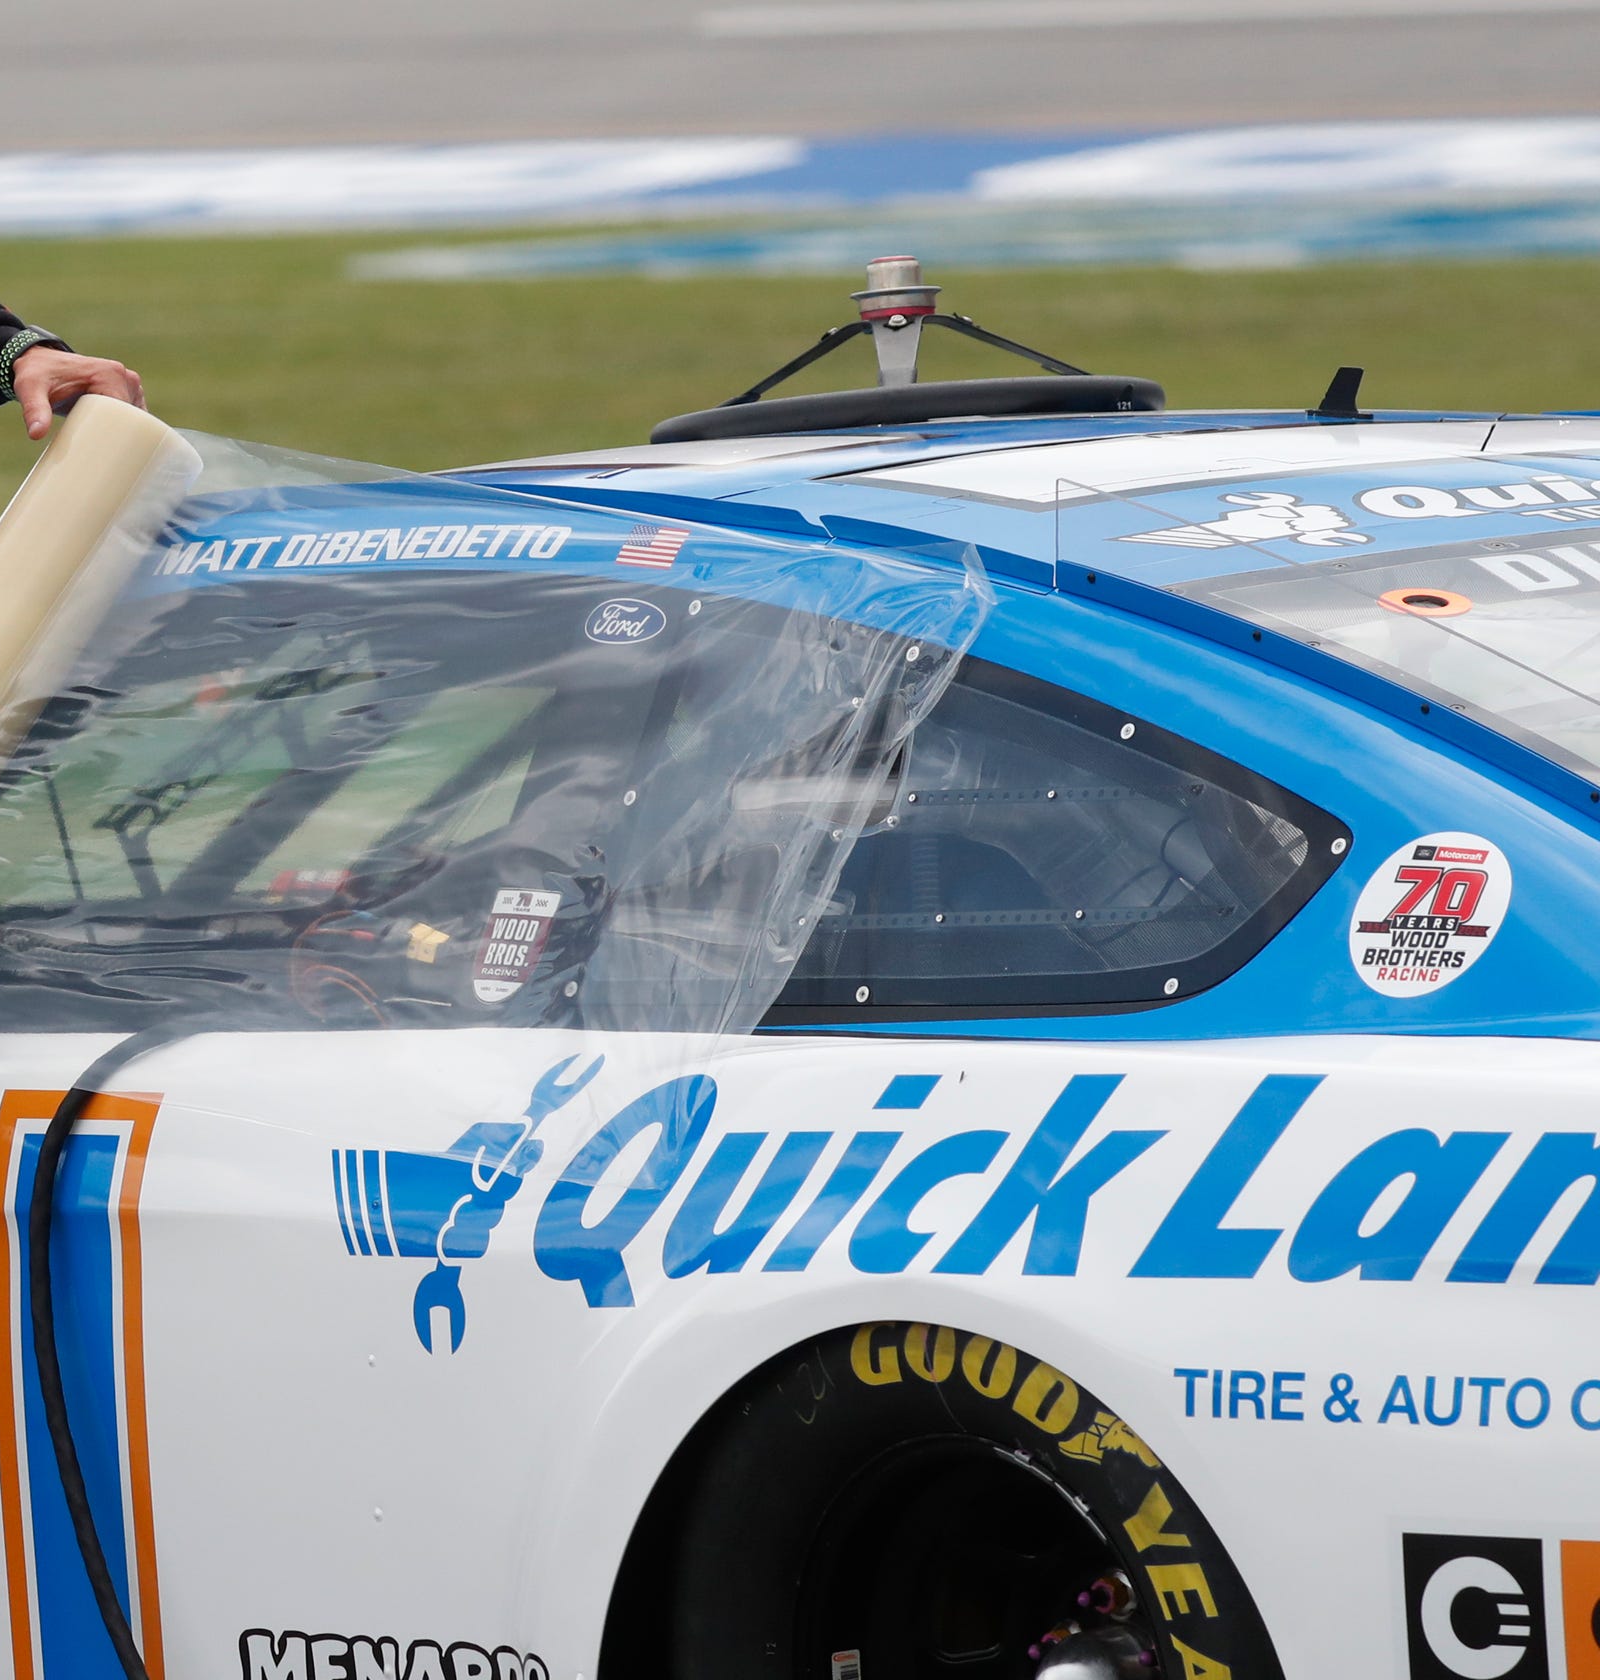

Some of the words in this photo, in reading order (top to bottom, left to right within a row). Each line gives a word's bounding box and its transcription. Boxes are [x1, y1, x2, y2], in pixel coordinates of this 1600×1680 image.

[1357, 474, 1600, 520] Quic
[153, 536, 281, 576] MATT
[275, 524, 572, 569] DiBENEDETTO
[593, 604, 650, 639] Ford
[1438, 849, 1483, 861] Motorcraft
[1383, 865, 1489, 924] 70
[491, 918, 540, 941] WOOD
[1395, 916, 1456, 930] YEARS
[1391, 931, 1450, 948] WOOD
[483, 943, 529, 967] BROS.
[1362, 949, 1466, 968] BROTHERS
[480, 968, 520, 977] RACING
[1376, 967, 1441, 982] RACING
[533, 1073, 1171, 1309] Quick
[1173, 1368, 1306, 1422] TIRE
[1324, 1373, 1362, 1423] &
[1378, 1375, 1551, 1431] AUTO
